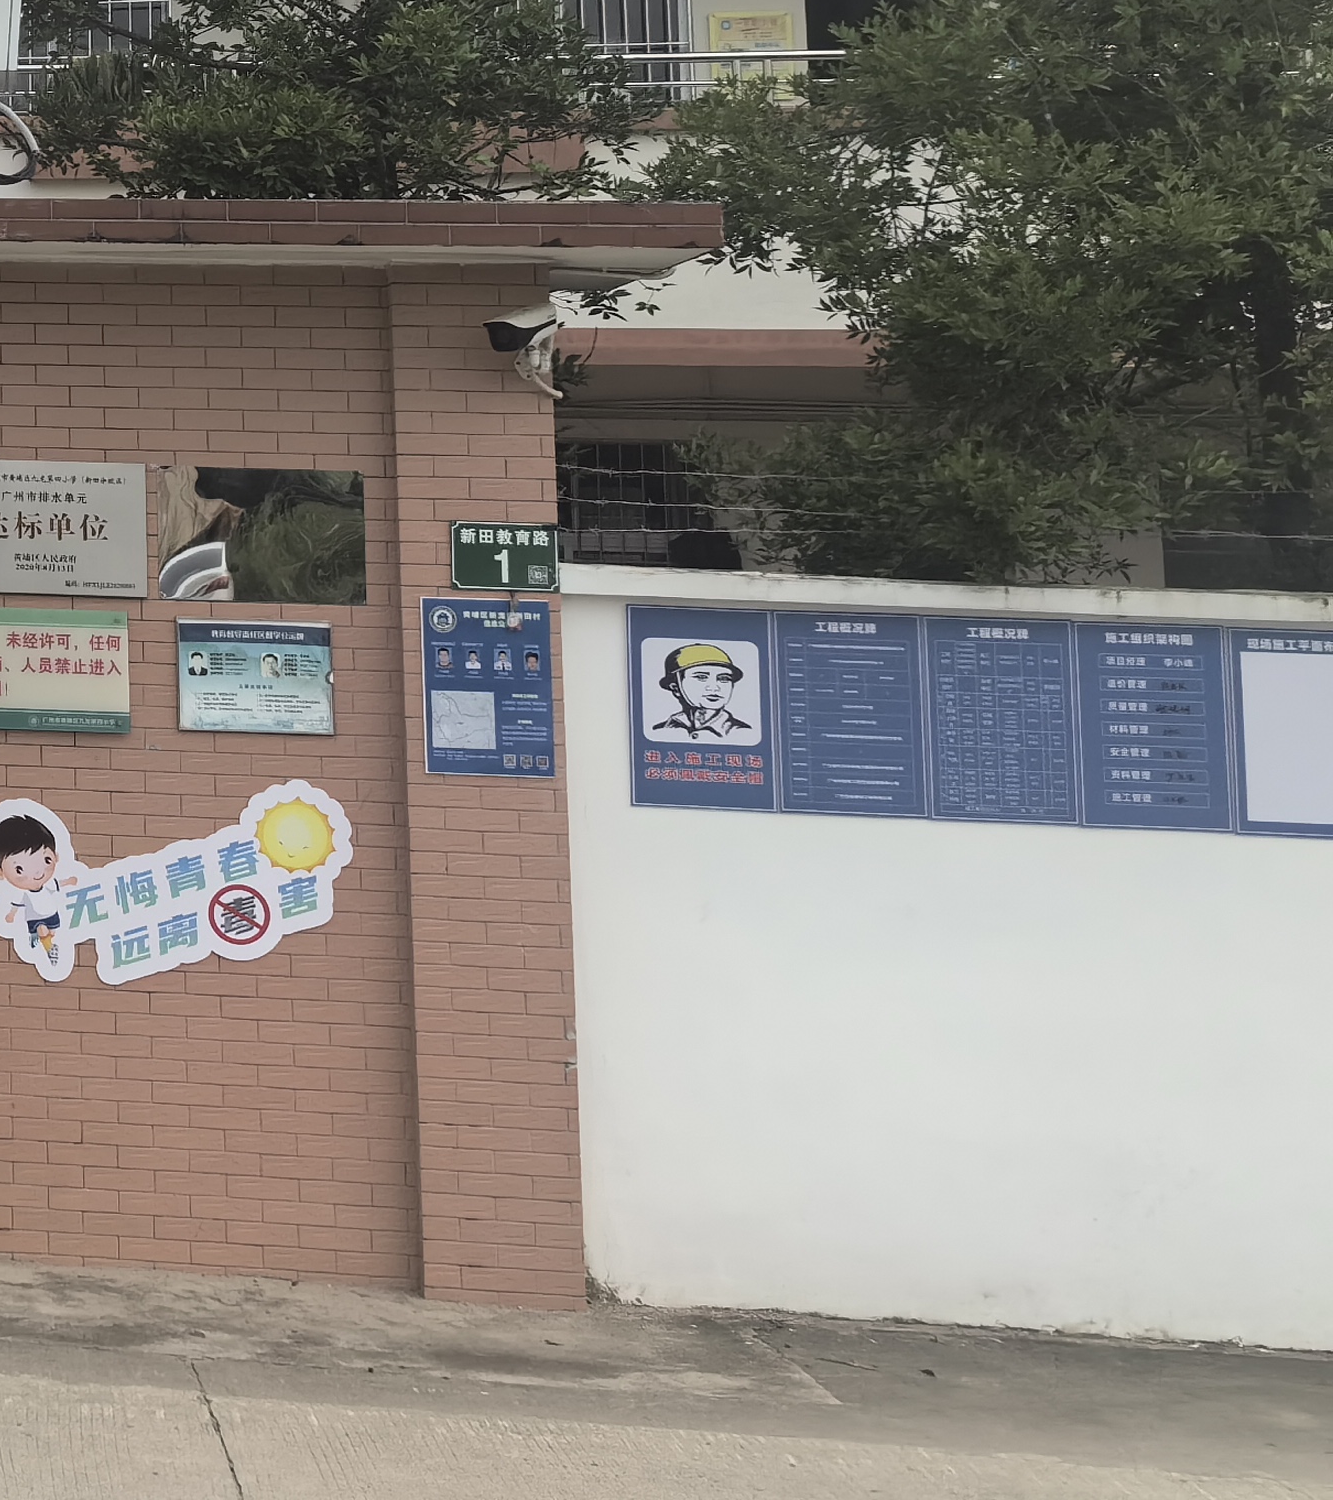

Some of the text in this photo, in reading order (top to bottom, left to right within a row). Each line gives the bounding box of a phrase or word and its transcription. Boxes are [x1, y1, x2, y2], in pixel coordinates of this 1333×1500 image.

[1, 491, 88, 504] 广州市排水单元
[460, 528, 550, 547] 新田教育路
[494, 549, 509, 583] 1
[6, 631, 122, 651] 未经许可，任何
[644, 750, 763, 768] 进入施工现场
[65, 840, 259, 930] 无悔青春
[111, 875, 318, 969] 远离毒害
